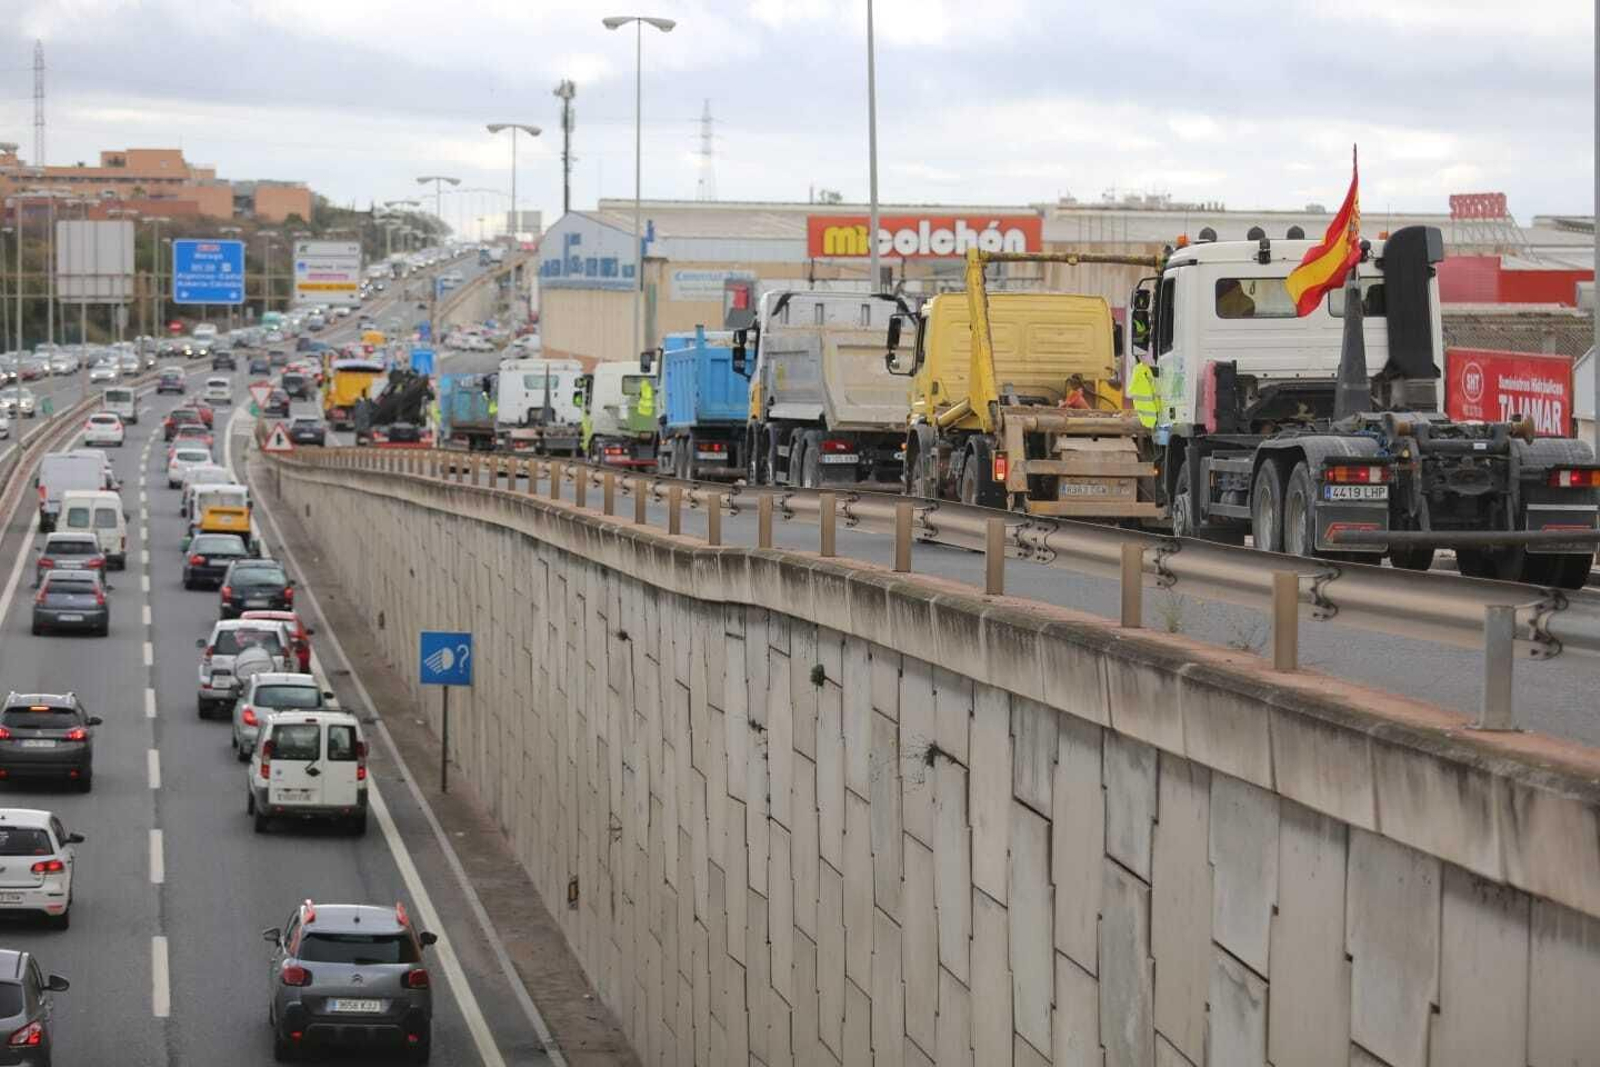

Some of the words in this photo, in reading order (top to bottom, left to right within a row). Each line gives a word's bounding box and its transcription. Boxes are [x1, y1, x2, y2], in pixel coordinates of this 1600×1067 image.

[823, 220, 1026, 255] micolchón
[1466, 373, 1480, 391] SHT
[1498, 394, 1562, 436] TAJAMAR
[1333, 486, 1361, 498] 4419
[1364, 486, 1385, 498] LHP
